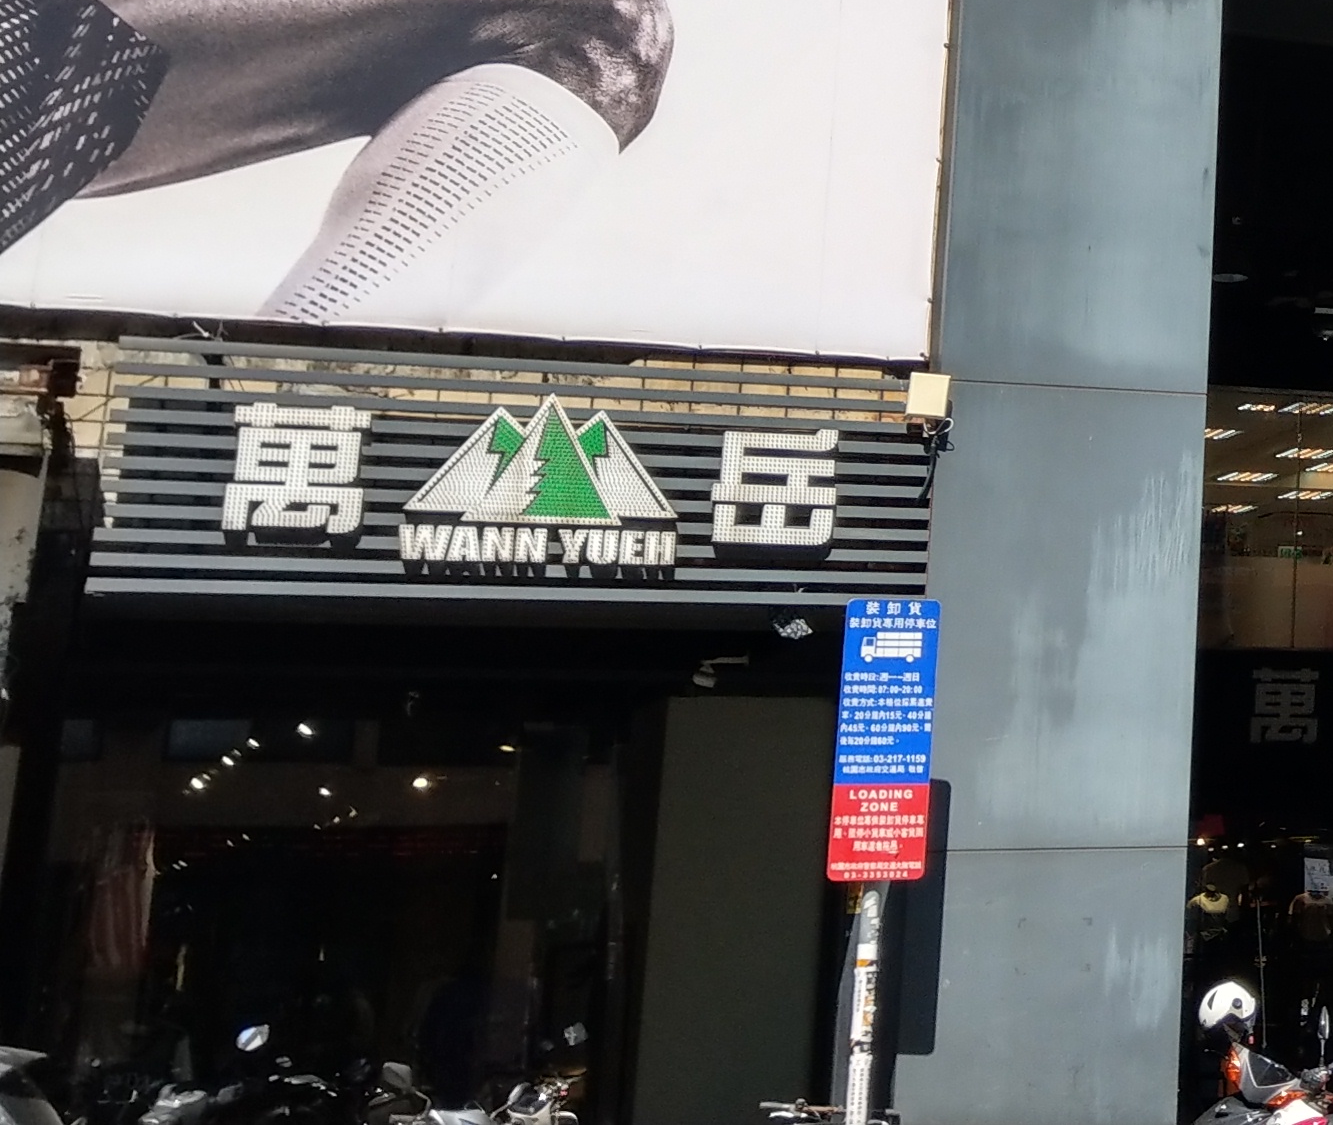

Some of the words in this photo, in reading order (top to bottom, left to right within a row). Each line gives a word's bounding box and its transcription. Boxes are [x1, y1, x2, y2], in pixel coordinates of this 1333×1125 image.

[223, 403, 371, 534] 萬
[400, 524, 549, 565] WANN
[557, 528, 677, 567] YUEH
[711, 429, 840, 547] 岳
[866, 601, 922, 615] 裝卸貨
[849, 617, 937, 629] 裝卸貨專用停車位
[1249, 667, 1321, 744] 萬
[849, 789, 914, 800] LOADING
[860, 802, 899, 812] ZONE
